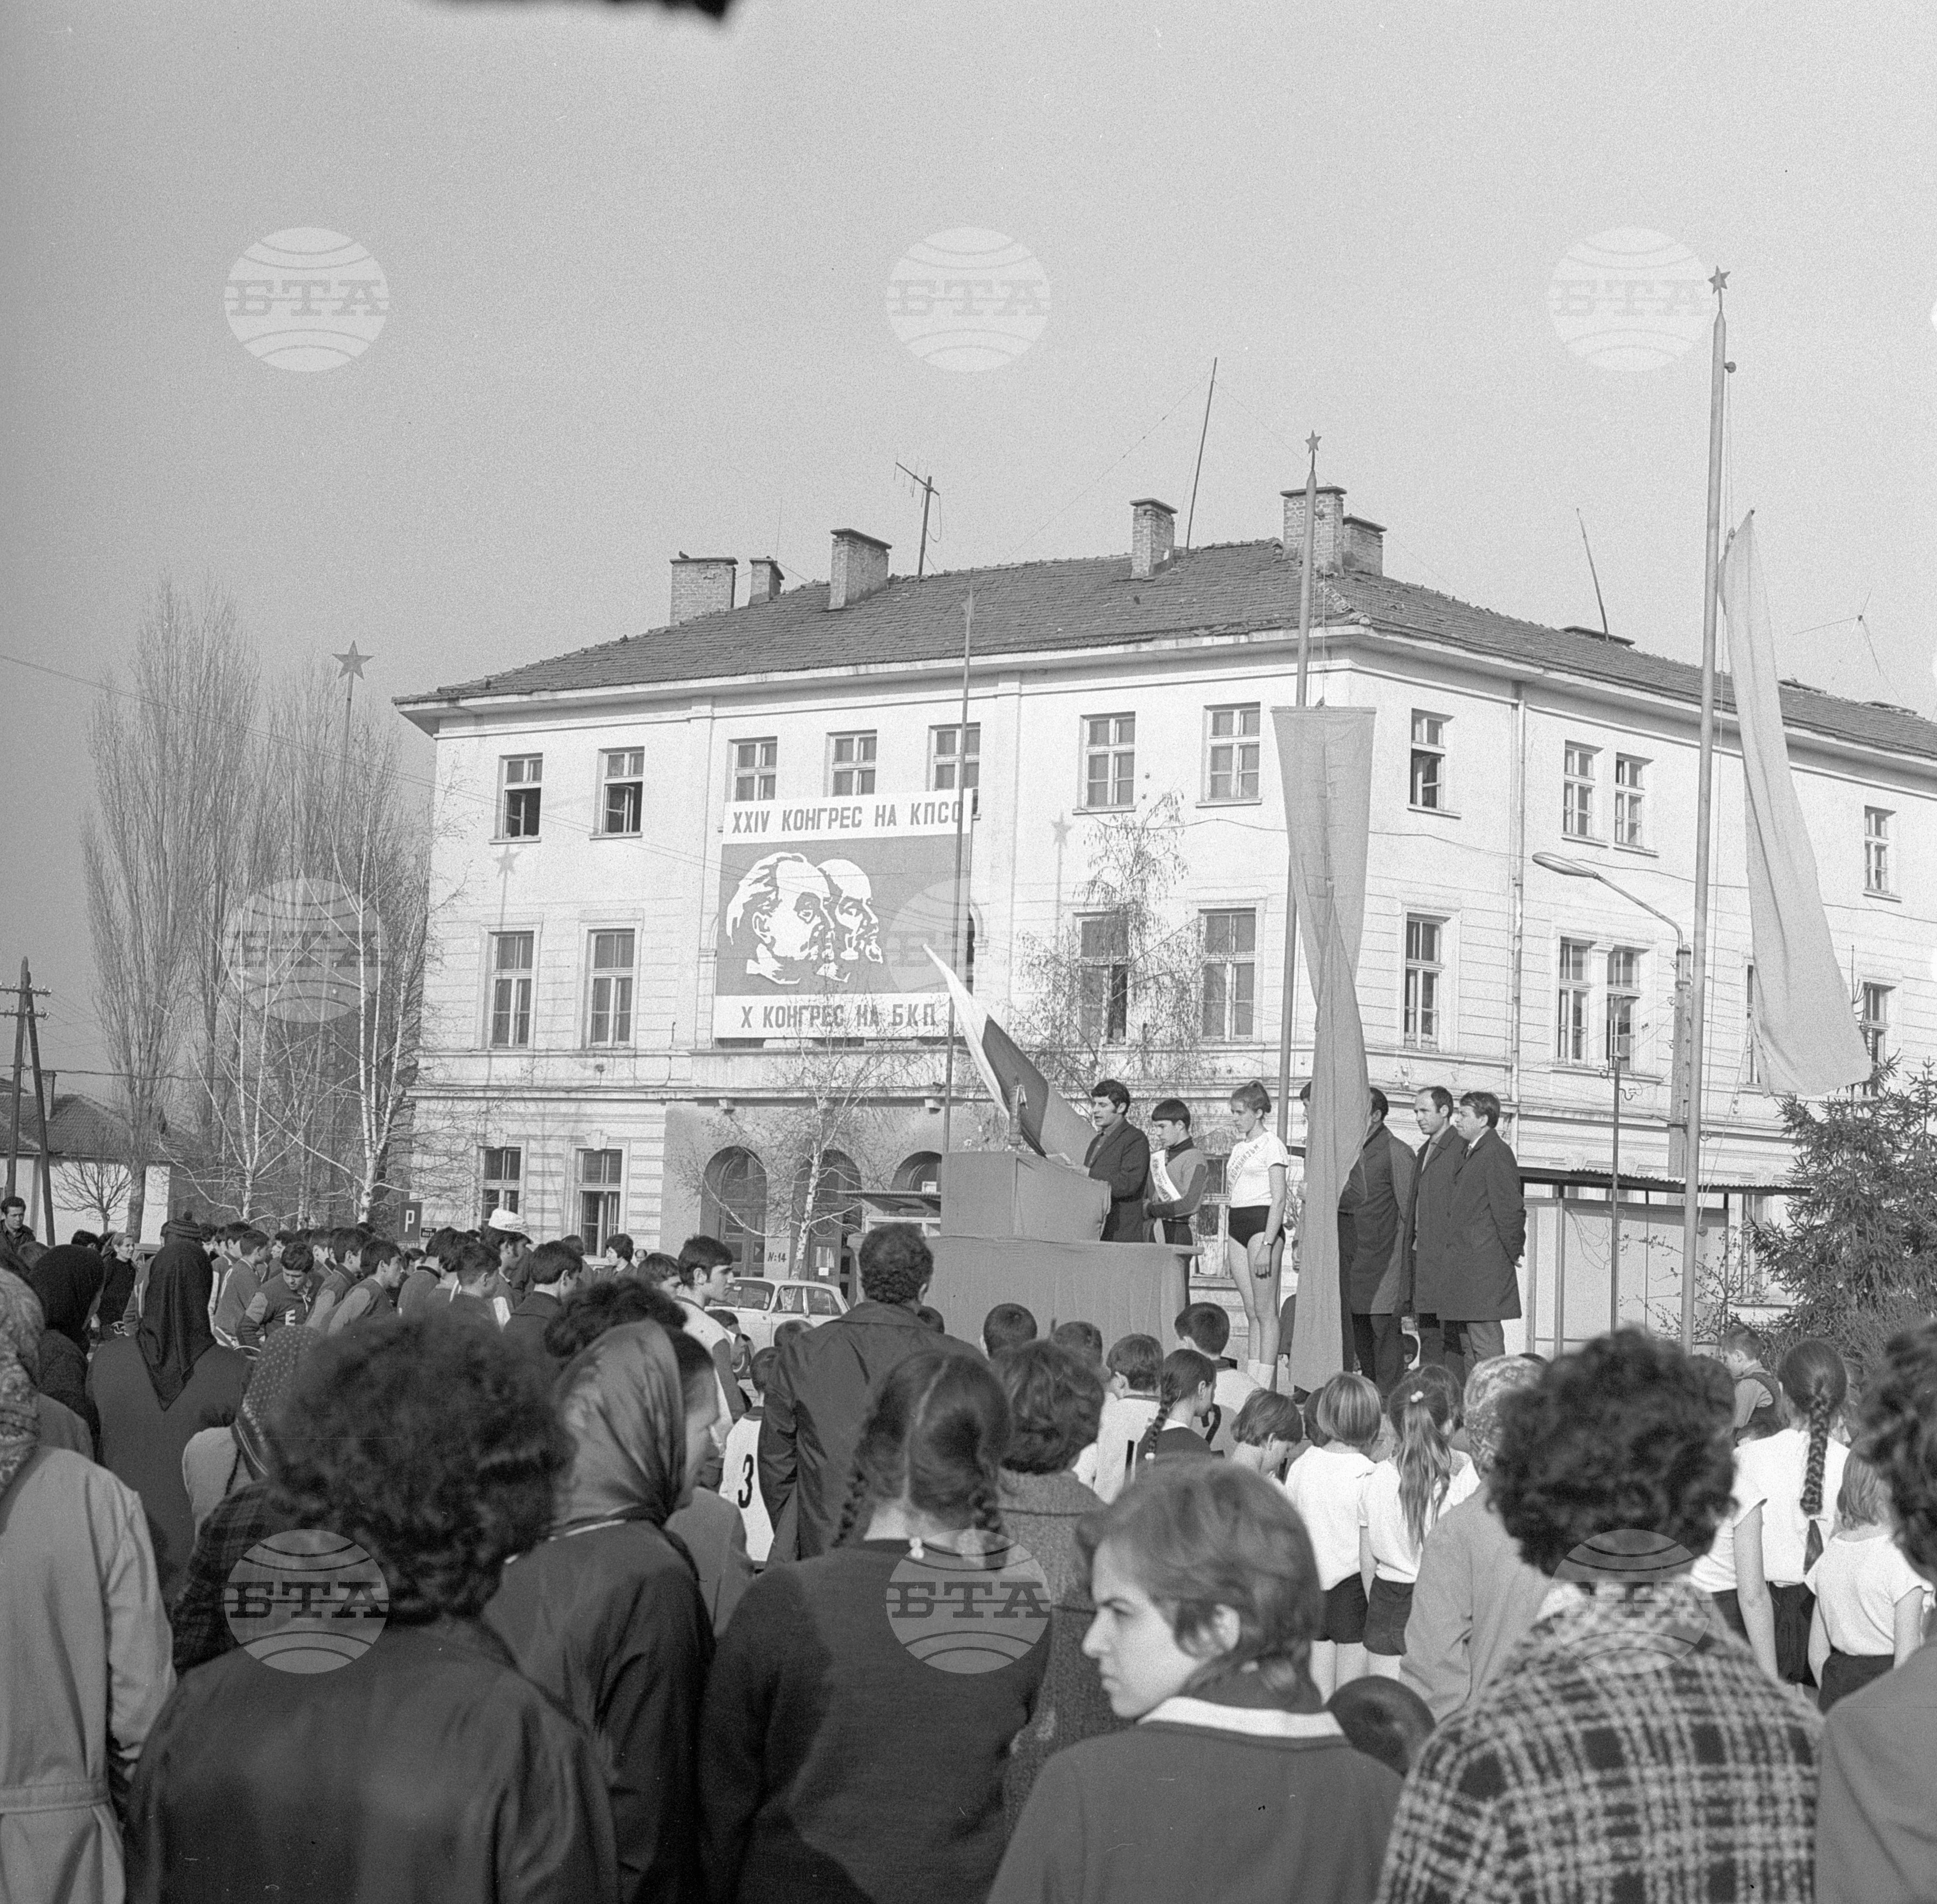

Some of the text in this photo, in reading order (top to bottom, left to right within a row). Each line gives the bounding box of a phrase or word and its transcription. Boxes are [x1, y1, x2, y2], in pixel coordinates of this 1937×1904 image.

[732, 810, 770, 834] XXIV
[781, 805, 863, 832] КОНГРЕС
[874, 805, 897, 827] НА
[741, 1004, 935, 1028] X КОНГРЕС НА БКП
[405, 1210, 415, 1233] P
[738, 1454, 754, 1508] 3
